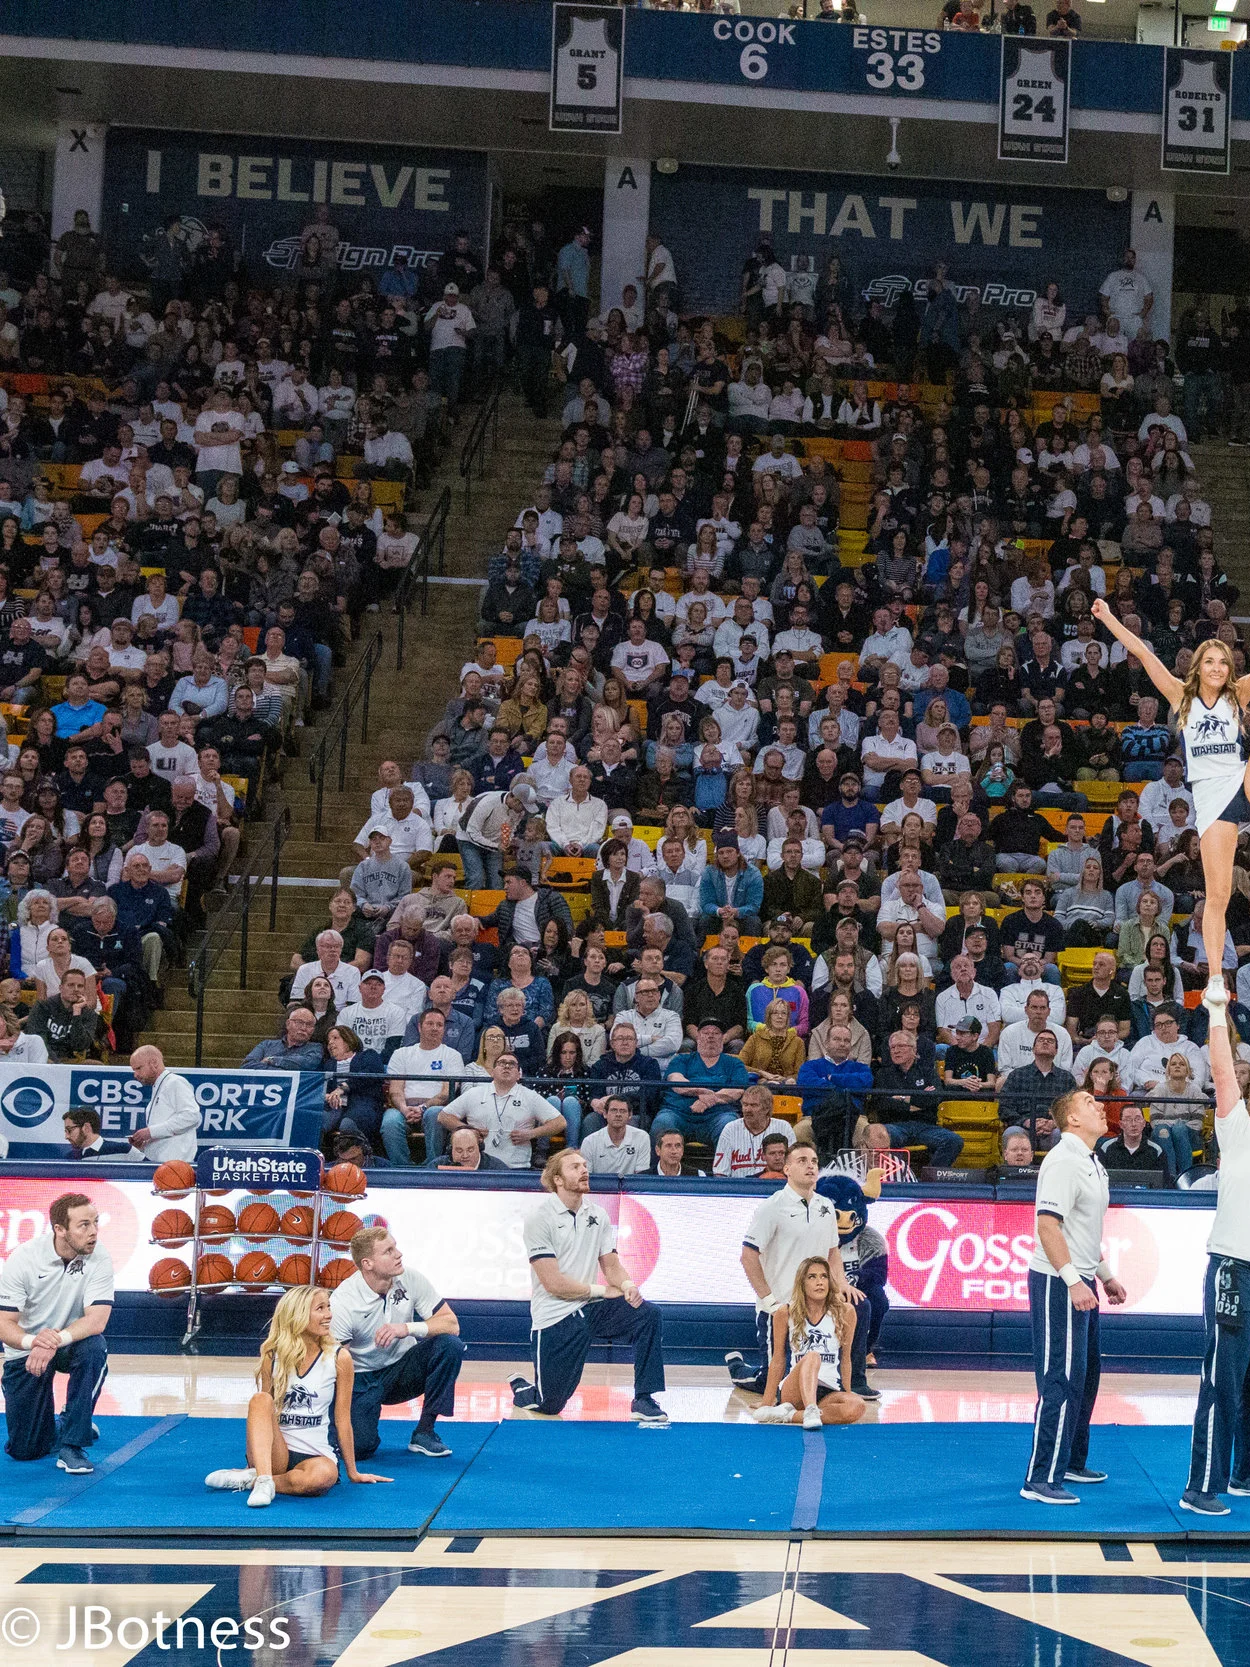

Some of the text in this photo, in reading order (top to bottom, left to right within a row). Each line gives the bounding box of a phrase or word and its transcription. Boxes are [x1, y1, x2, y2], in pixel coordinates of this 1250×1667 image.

[713, 20, 796, 45] COOK
[852, 28, 941, 54] ESTES
[569, 49, 606, 59] GRANT
[739, 43, 768, 80] 6
[577, 64, 597, 90] 5
[866, 52, 925, 91] 33
[1016, 79, 1052, 90] GREEN
[1175, 90, 1221, 102] ROBERTS
[1012, 93, 1056, 122] 24
[1177, 106, 1215, 133] 31
[70, 129, 89, 153] X
[146, 150, 451, 211] I BELIEVE
[616, 166, 639, 190] A
[748, 188, 1043, 248] THAT WE
[1143, 200, 1164, 223] A
[338, 242, 386, 269] ign
[983, 283, 1037, 307] Pro
[1190, 742, 1236, 758] UTAH STATE
[363, 871, 398, 884] UTAH STATE
[1014, 940, 1045, 952] STATE
[77, 1079, 283, 1107] CBS ORTS
[212, 1157, 307, 1174] UtahState
[711, 1154, 722, 1168] 7
[731, 1150, 752, 1163] Mud
[211, 1171, 308, 1184] BASKETBALL
[962, 1280, 1030, 1299] FOO
[297, 1415, 322, 1426] STATE
